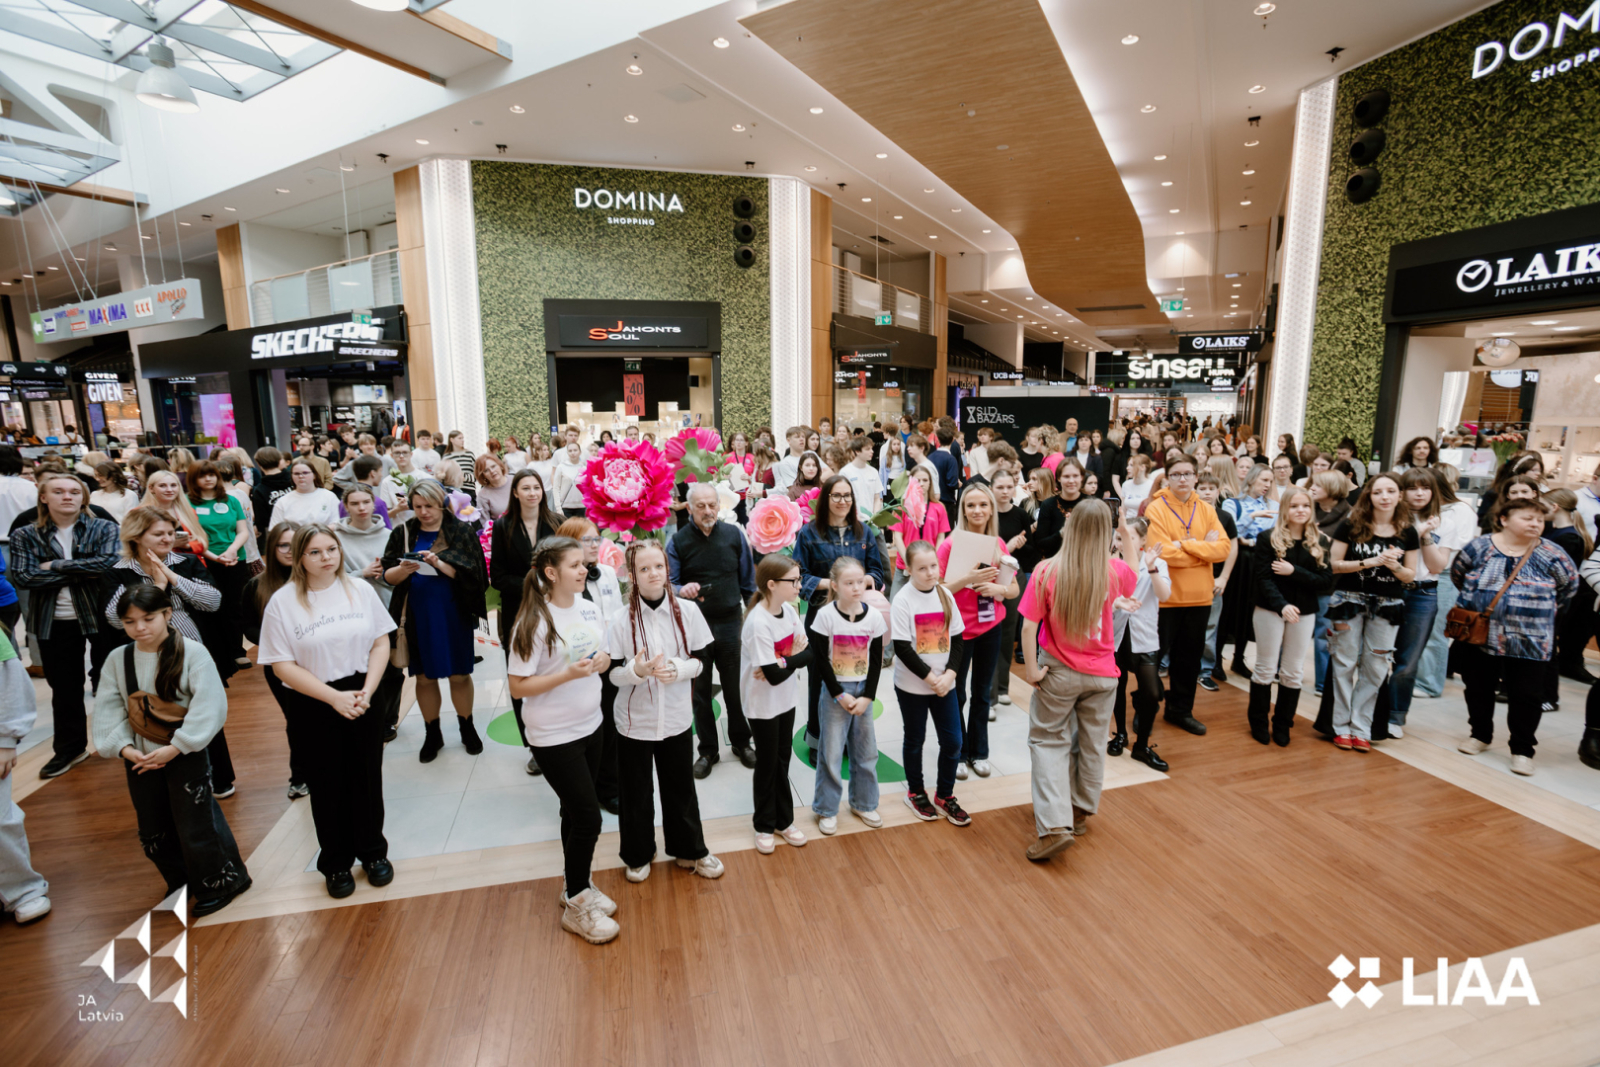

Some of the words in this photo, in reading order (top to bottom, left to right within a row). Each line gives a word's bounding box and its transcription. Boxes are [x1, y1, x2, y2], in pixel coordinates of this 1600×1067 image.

[1530, 47, 1600, 82] SHOPP
[574, 188, 684, 212] DOMINA
[607, 217, 655, 226] SHOPPING
[157, 287, 187, 304] APOLLO
[1495, 281, 1559, 297] JEWELLERY
[1561, 280, 1569, 288] &
[88, 302, 127, 326] MAXIMA
[608, 320, 681, 333] JAHONTS
[588, 328, 640, 341] SOUL
[1205, 337, 1247, 348] LAIKS
[338, 347, 399, 357] SKECHERS
[1009, 372, 1024, 380] shop
[1212, 377, 1232, 386] Gabi
[87, 383, 124, 402] GIVEN
[1190, 400, 1234, 415] sinsay
[293, 614, 336, 640] Elegantas
